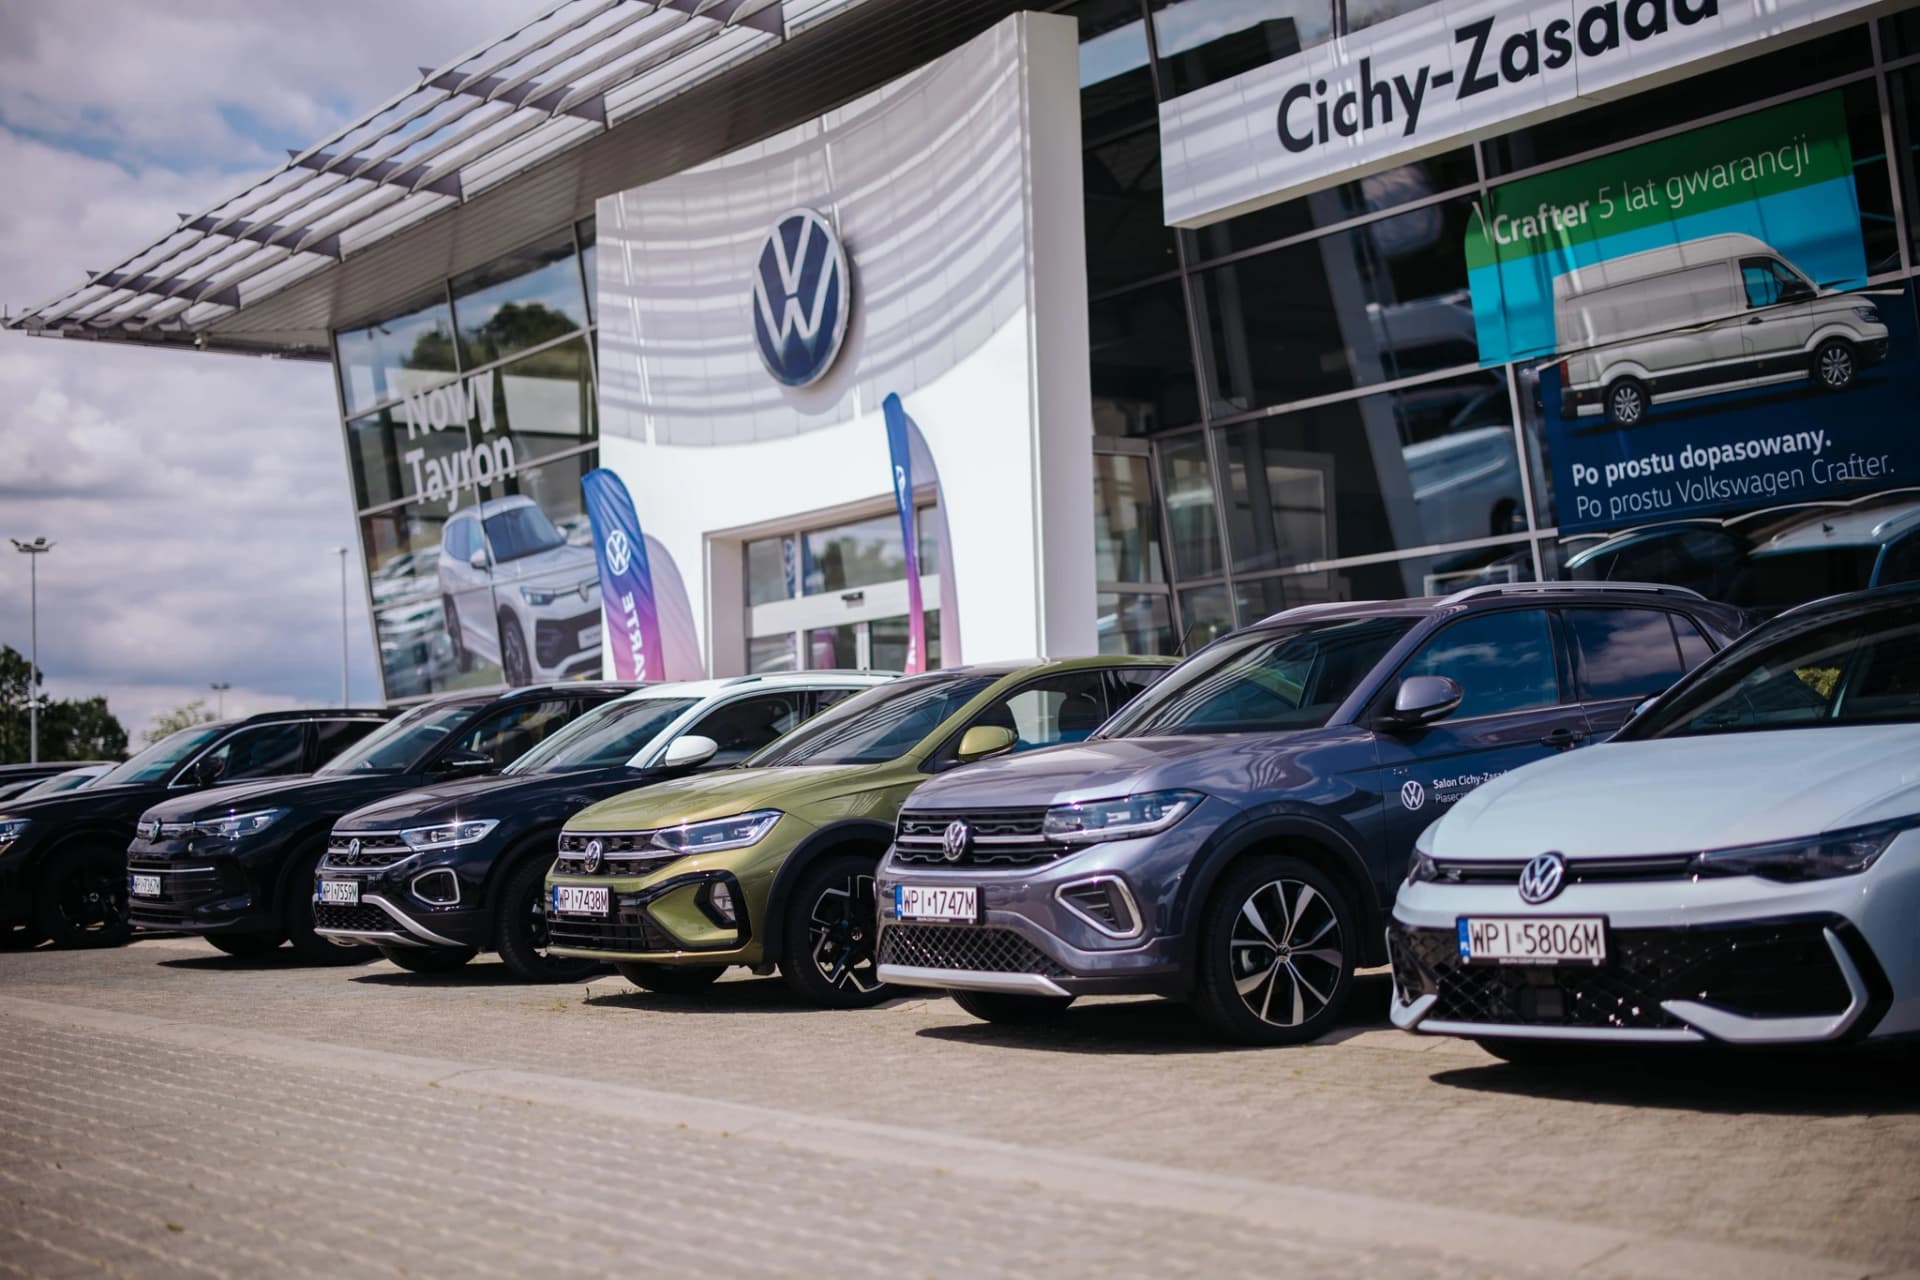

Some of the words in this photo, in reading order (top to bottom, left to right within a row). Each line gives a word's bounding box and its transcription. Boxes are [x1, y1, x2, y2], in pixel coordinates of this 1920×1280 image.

[1492, 199, 1590, 245] Crafter
[1598, 187, 1614, 219] 5
[1623, 179, 1659, 213] lat
[1666, 133, 1811, 209] gwarancji
[405, 369, 496, 440] Nowy
[405, 435, 517, 512] Tayron
[1571, 463, 1598, 486] Po
[1605, 453, 1675, 487] prostu
[1680, 429, 1832, 471] dopasowany.
[1577, 495, 1601, 519] Po
[1610, 485, 1672, 520] prostu
[1676, 467, 1804, 504] Volkswagen
[1811, 452, 1895, 484] Crafter.
[1433, 778, 1457, 790] Salon
[578, 889, 608, 911] 7438M
[902, 889, 925, 914] WPI
[933, 890, 975, 916] 1747M
[1471, 923, 1511, 954] WPI
[1523, 923, 1601, 955] 5806M
